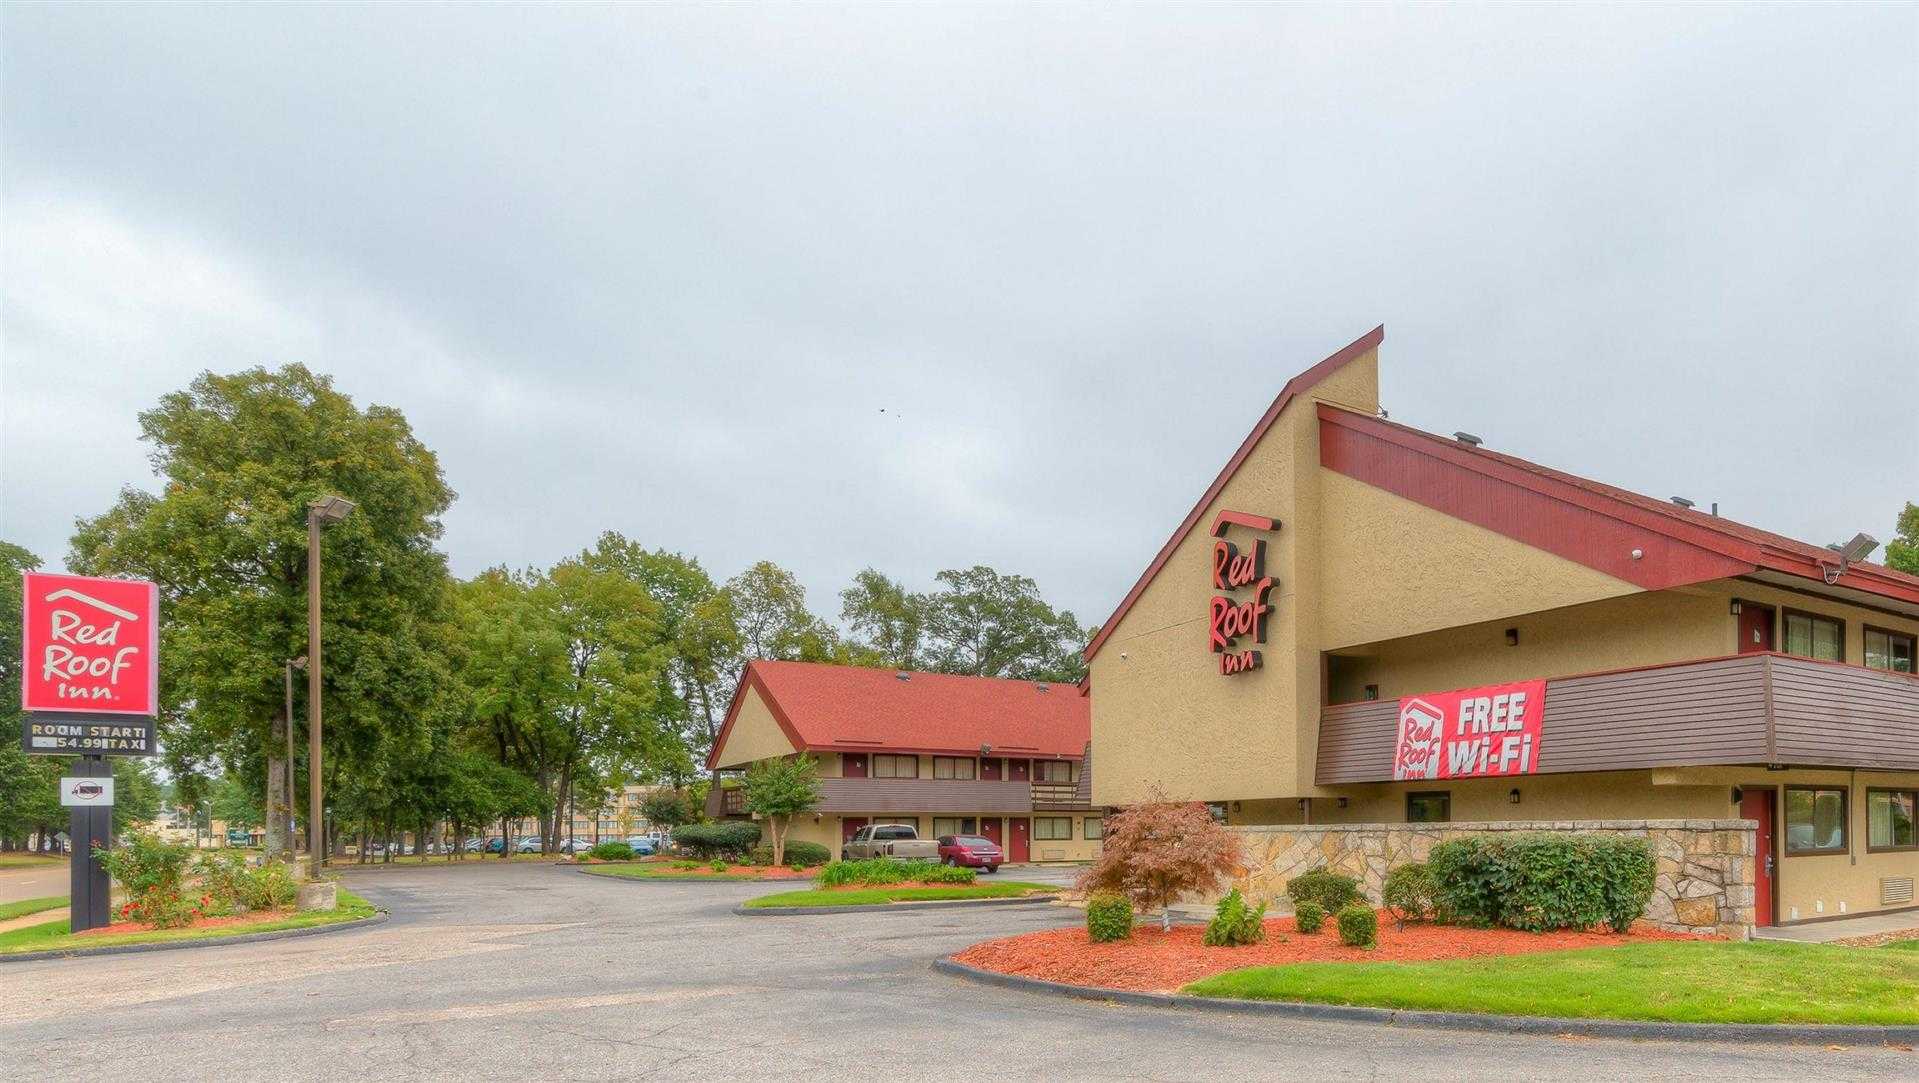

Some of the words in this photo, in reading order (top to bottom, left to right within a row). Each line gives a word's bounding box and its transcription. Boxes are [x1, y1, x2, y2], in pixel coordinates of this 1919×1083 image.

[1213, 538, 1266, 590] Red
[51, 610, 120, 646] Red
[1210, 576, 1272, 652] Roof
[43, 645, 139, 685] Roof
[32, 724, 83, 736] ROOM
[1404, 717, 1435, 744] Red
[1457, 692, 1525, 736] FREE
[57, 738, 102, 749] 54.99
[1399, 737, 1440, 769] Roof
[1448, 733, 1532, 776] Wi-Fi
